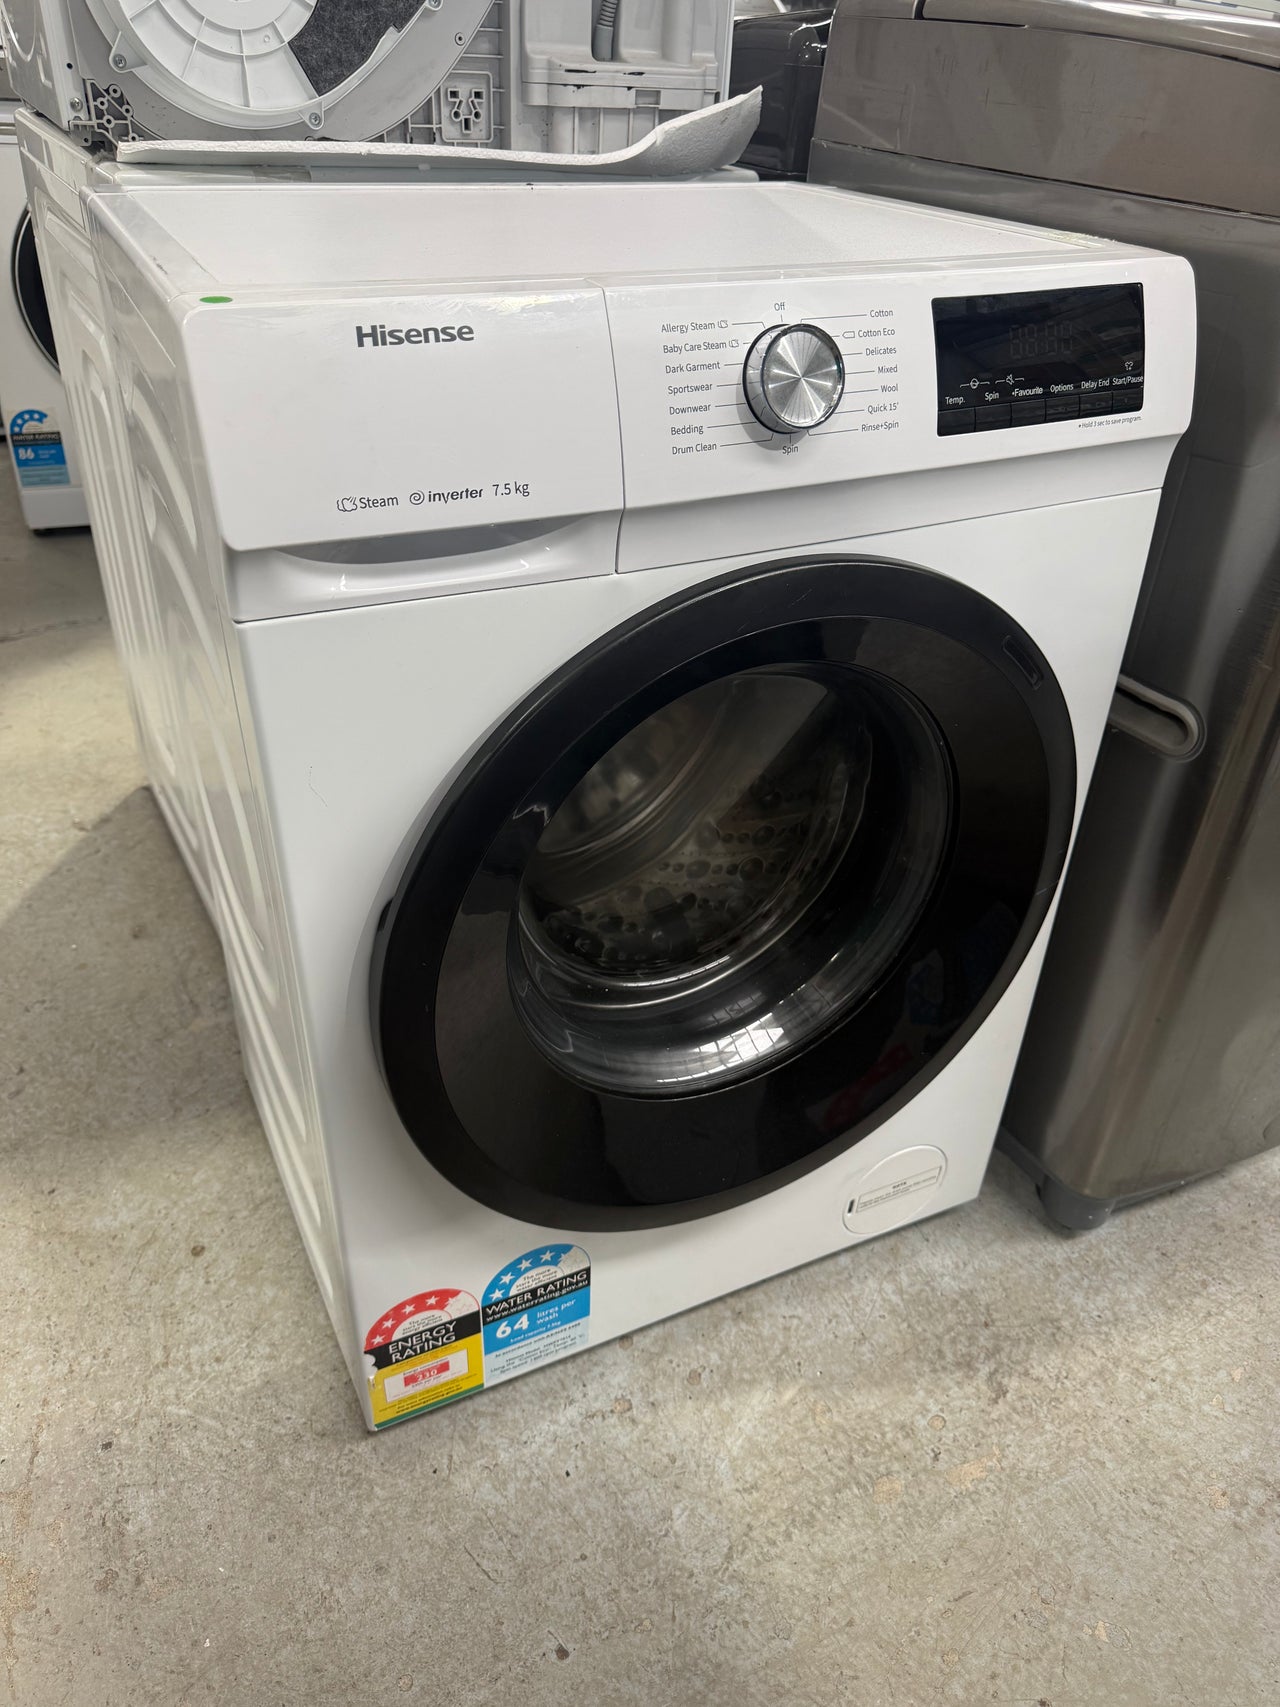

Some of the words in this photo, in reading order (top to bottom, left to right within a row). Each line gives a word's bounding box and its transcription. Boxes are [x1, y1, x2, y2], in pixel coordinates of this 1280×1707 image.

[774, 302, 786, 311] Off
[870, 310, 893, 318] Cotton
[661, 324, 688, 334] Allergy
[690, 322, 715, 330] Steam
[858, 330, 881, 338] Cotton
[883, 328, 895, 336] Eco
[356, 325, 474, 347] Hisense
[663, 344, 682, 354] Baby
[684, 343, 702, 352] Care
[702, 341, 726, 350] Steam
[866, 347, 896, 356] Delicates
[666, 364, 684, 373] Dark
[686, 361, 720, 372] Garment
[878, 364, 898, 374] Mixed
[1081, 381, 1097, 389] Delay
[1099, 378, 1109, 386] End
[1112, 376, 1143, 386] Start/Pause
[668, 384, 712, 396] Sportswear
[880, 384, 898, 392] Wool
[1050, 383, 1074, 394] Options
[945, 396, 965, 405] Temp.
[984, 391, 1000, 402] Spin
[669, 404, 711, 415] Downwear
[868, 403, 888, 414] Quick
[671, 425, 704, 436] Bedding
[862, 420, 899, 432] Rinse+Spin
[672, 446, 693, 455] Drum
[696, 443, 717, 452] Clean
[782, 444, 798, 456] Spin
[492, 483, 511, 496] 7.5
[514, 481, 530, 497] kg
[428, 488, 483, 503] inverter
[360, 496, 398, 508] Steam
[486, 1292, 532, 1314] WATER
[537, 1271, 586, 1296] RATING
[562, 1299, 576, 1310] per
[496, 1314, 530, 1338] 64
[388, 1321, 456, 1354] ENERGY
[392, 1332, 456, 1363] RATING
[417, 1369, 437, 1380] 230
